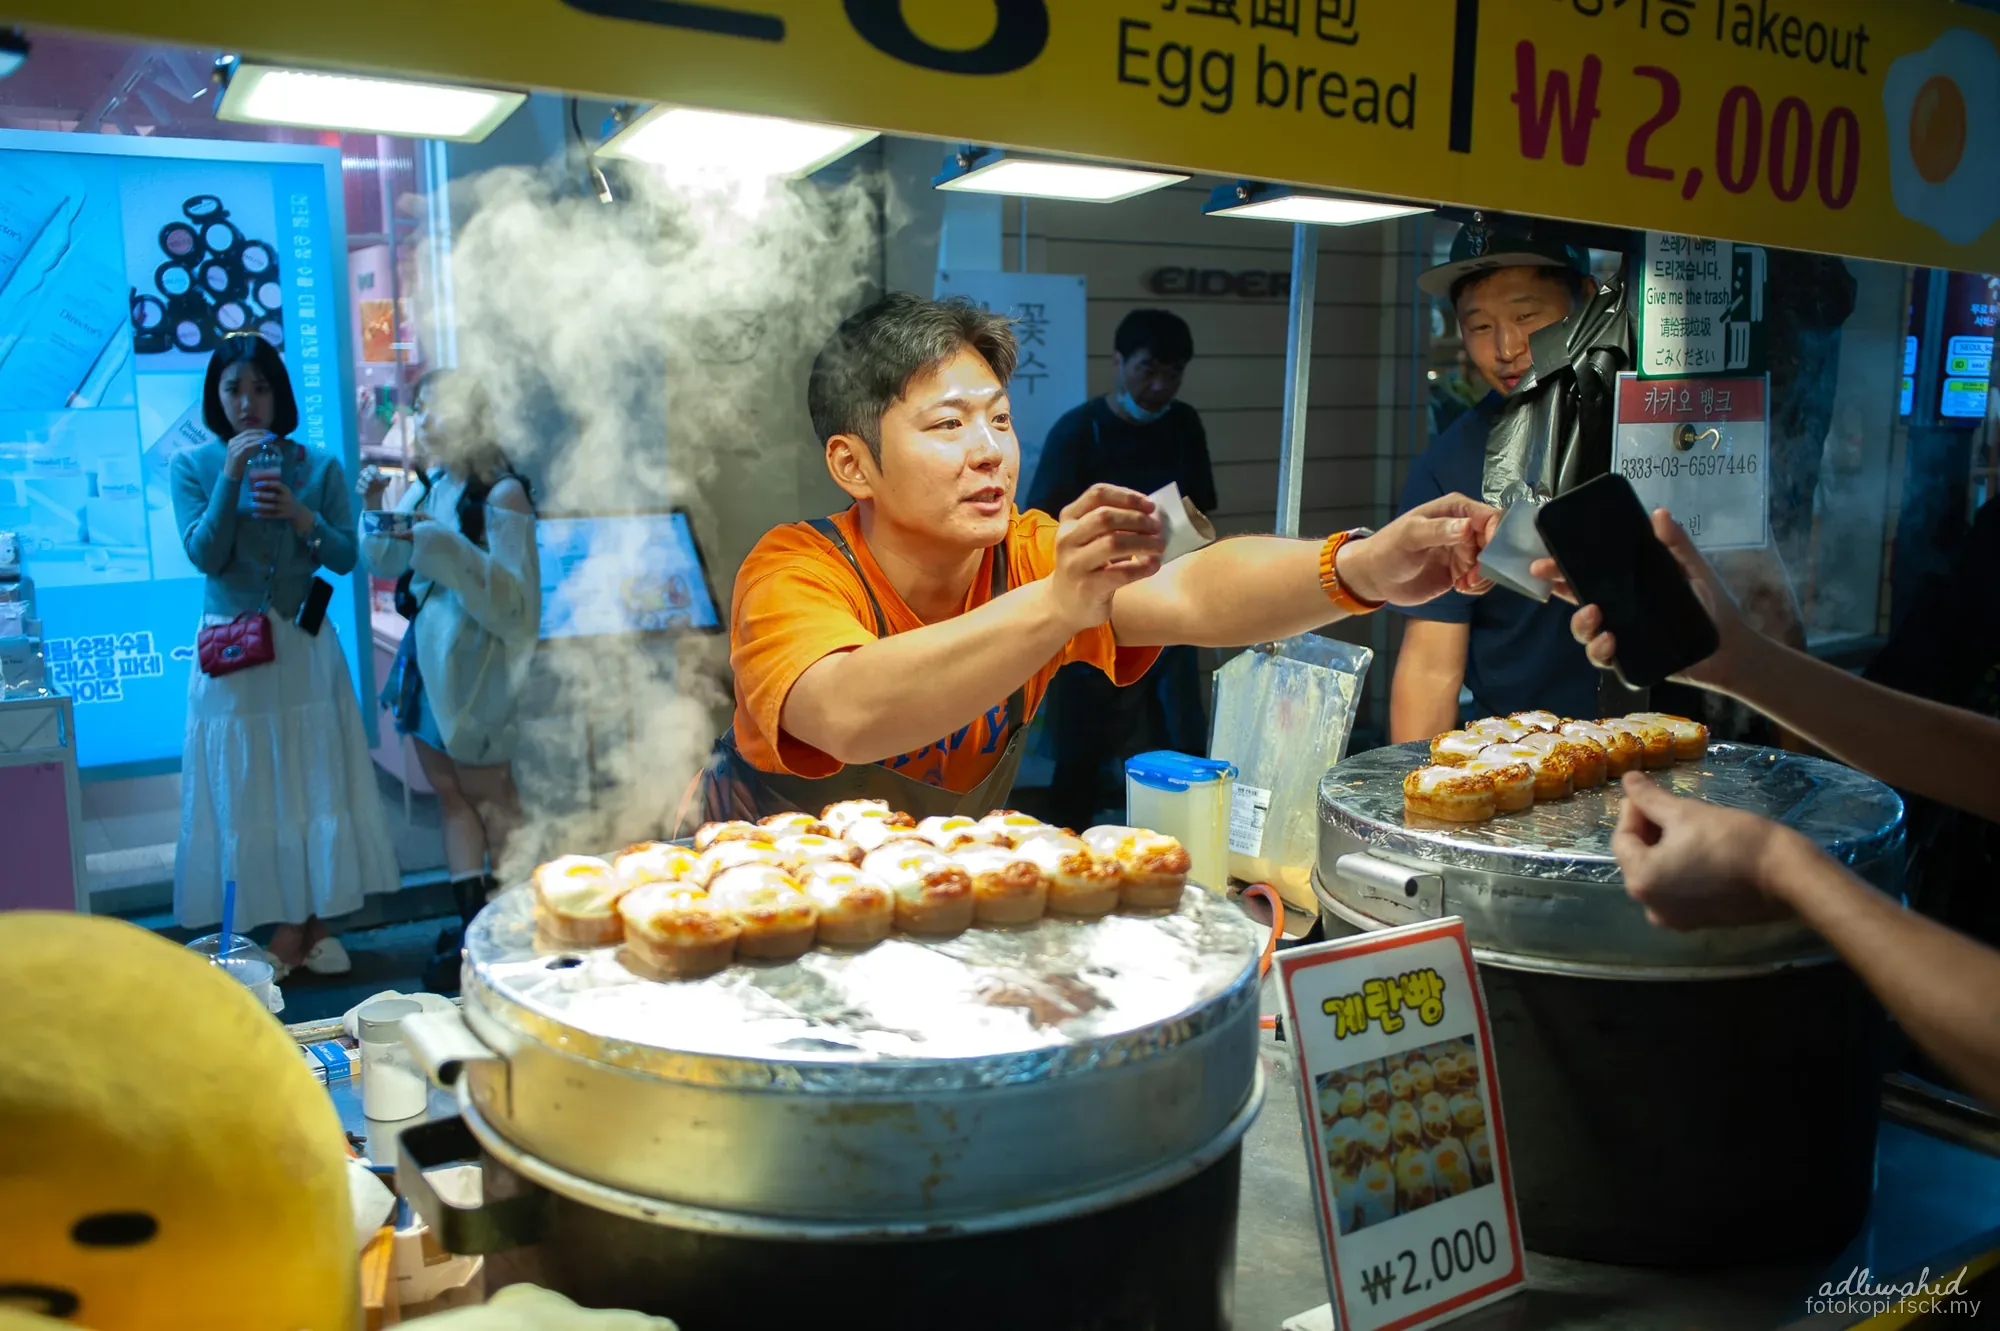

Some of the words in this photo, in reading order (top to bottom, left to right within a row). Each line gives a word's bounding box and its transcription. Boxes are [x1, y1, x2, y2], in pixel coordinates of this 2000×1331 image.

[1118, 18, 1235, 114] Egg
[1256, 44, 1417, 130] bread
[1659, 235, 1690, 256] 쓰레기
[1654, 259, 1722, 281] 드리겠습니다.
[1646, 287, 1666, 305] Give
[1669, 291, 1683, 305] me
[1686, 287, 1702, 305] the
[1660, 315, 1712, 338] 请给我垃圾
[1655, 347, 1716, 367] ごみください
[1645, 387, 1692, 416] 카카오
[1701, 387, 1732, 415] 뱅크
[1621, 453, 1757, 480] 3333-03-6597446
[1322, 968, 1446, 1039] 계란빵
